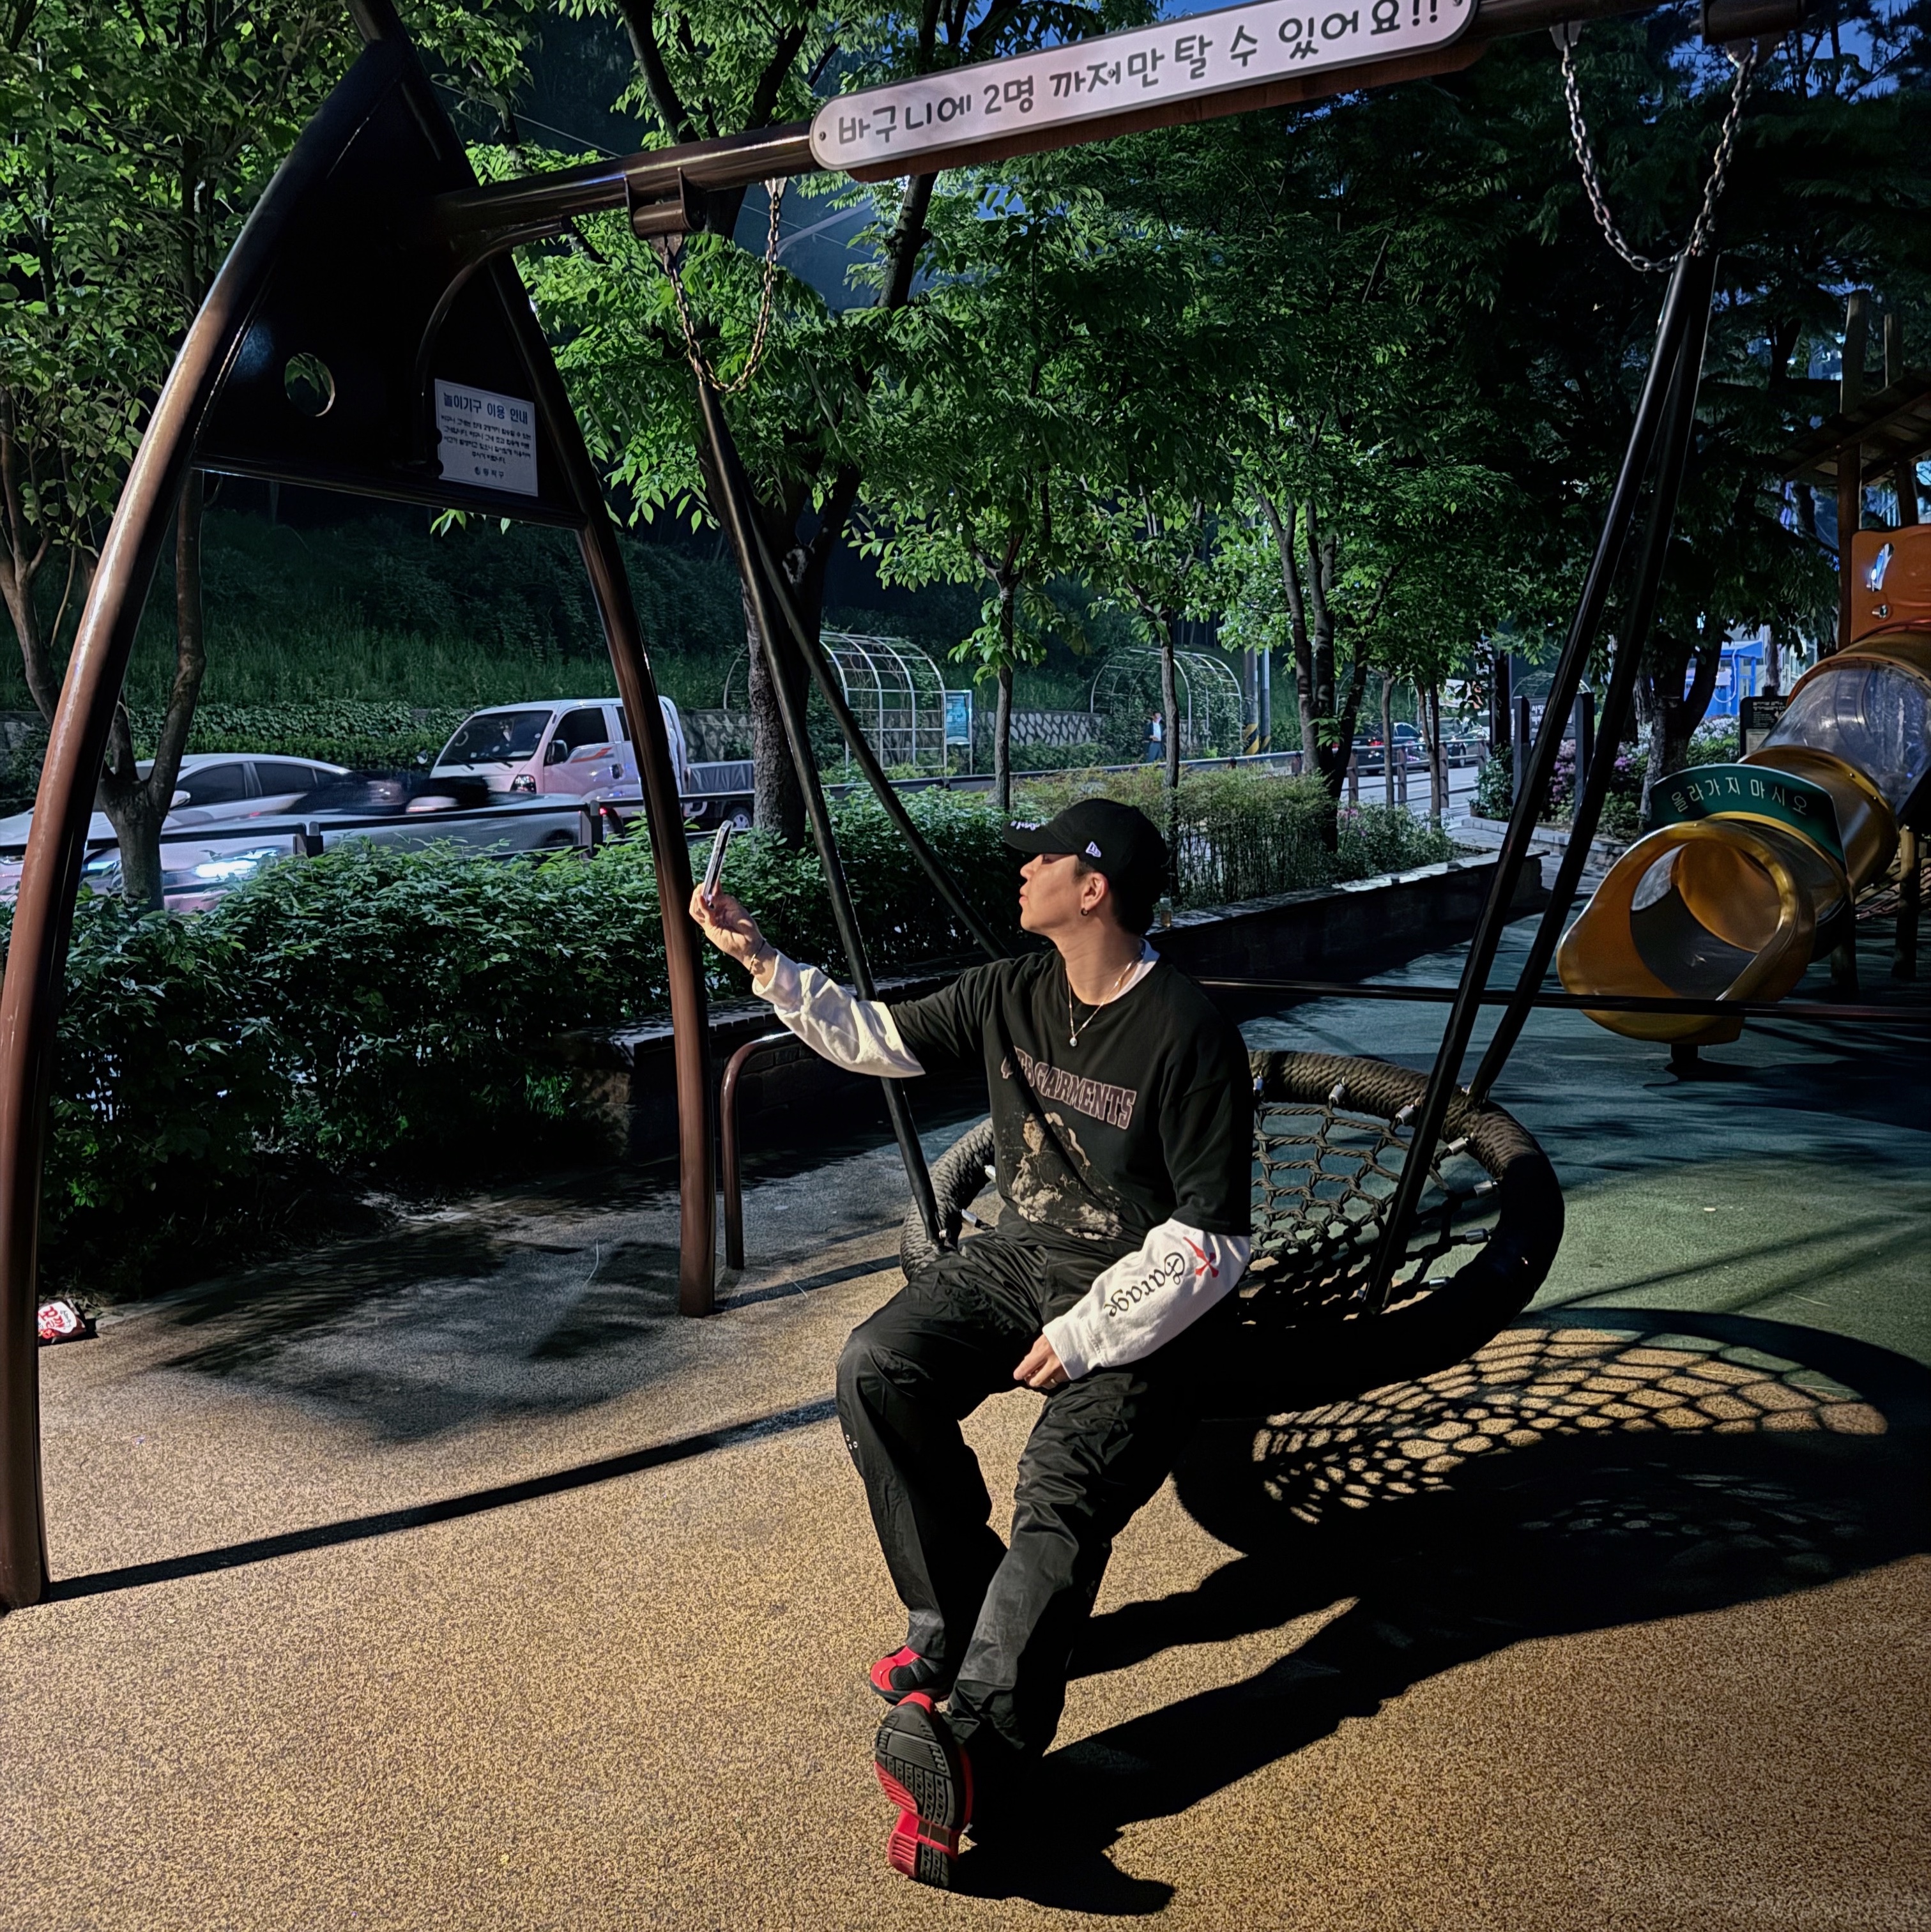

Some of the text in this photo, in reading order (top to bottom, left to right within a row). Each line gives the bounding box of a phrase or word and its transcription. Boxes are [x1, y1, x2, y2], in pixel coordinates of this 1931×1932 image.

[838, 96, 972, 146] 바구니에
[983, 74, 1035, 115] 2명
[1174, 34, 1213, 80] 탈
[1228, 24, 1258, 68] 수
[1278, 0, 1438, 60] 있어요!!
[444, 392, 528, 425] 놀이기구 이용 안내
[1671, 777, 1807, 816] 올라가지 마시오
[1034, 1061, 1137, 1130] GARMENTS
[1104, 1251, 1186, 1318] Garage
